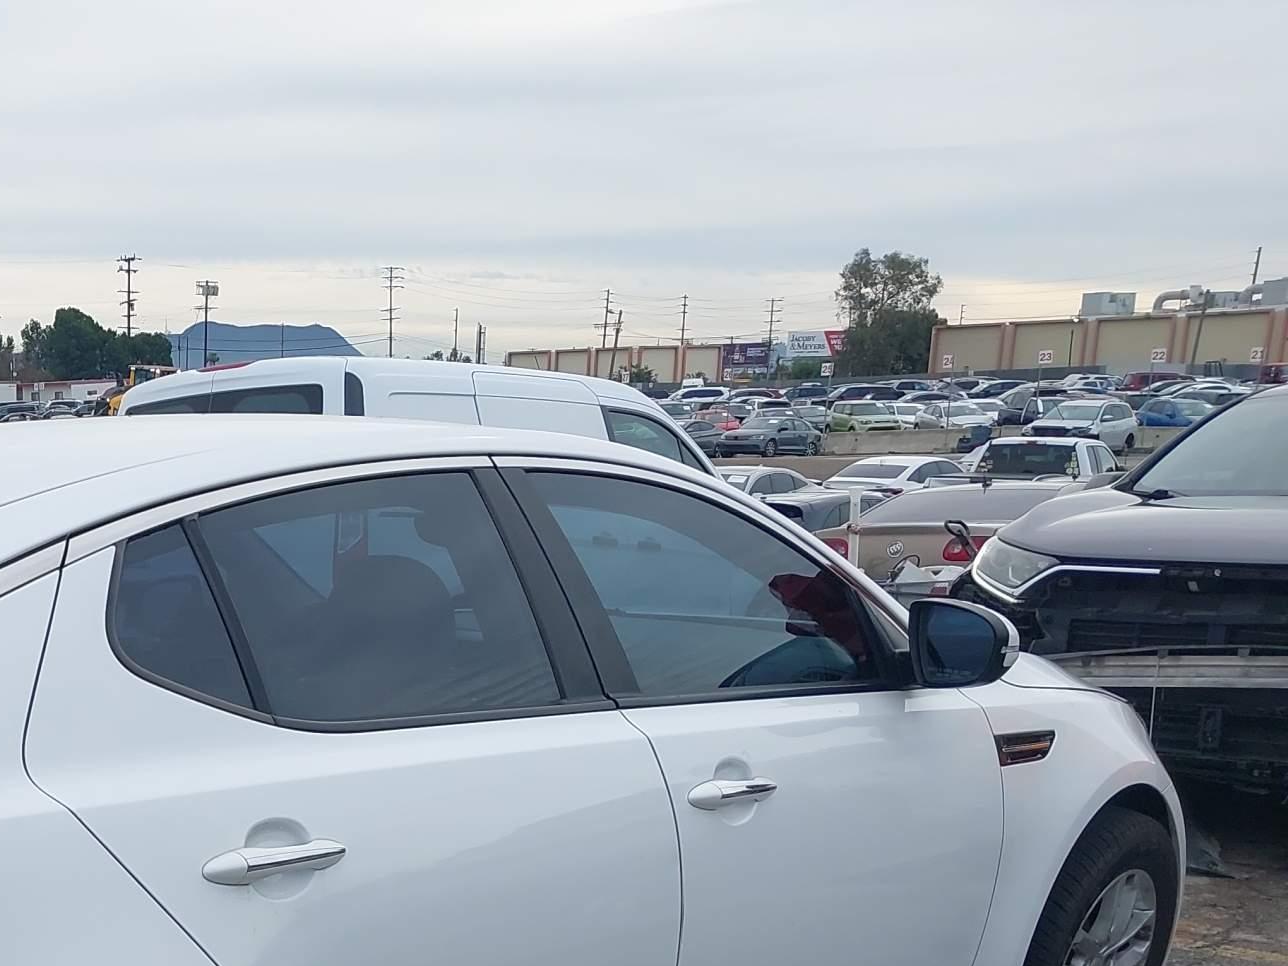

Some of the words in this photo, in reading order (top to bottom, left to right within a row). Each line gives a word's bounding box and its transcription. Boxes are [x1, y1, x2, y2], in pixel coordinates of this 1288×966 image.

[1039, 352, 1052, 361] 23
[1152, 351, 1165, 360] 22
[1252, 350, 1263, 359] 21
